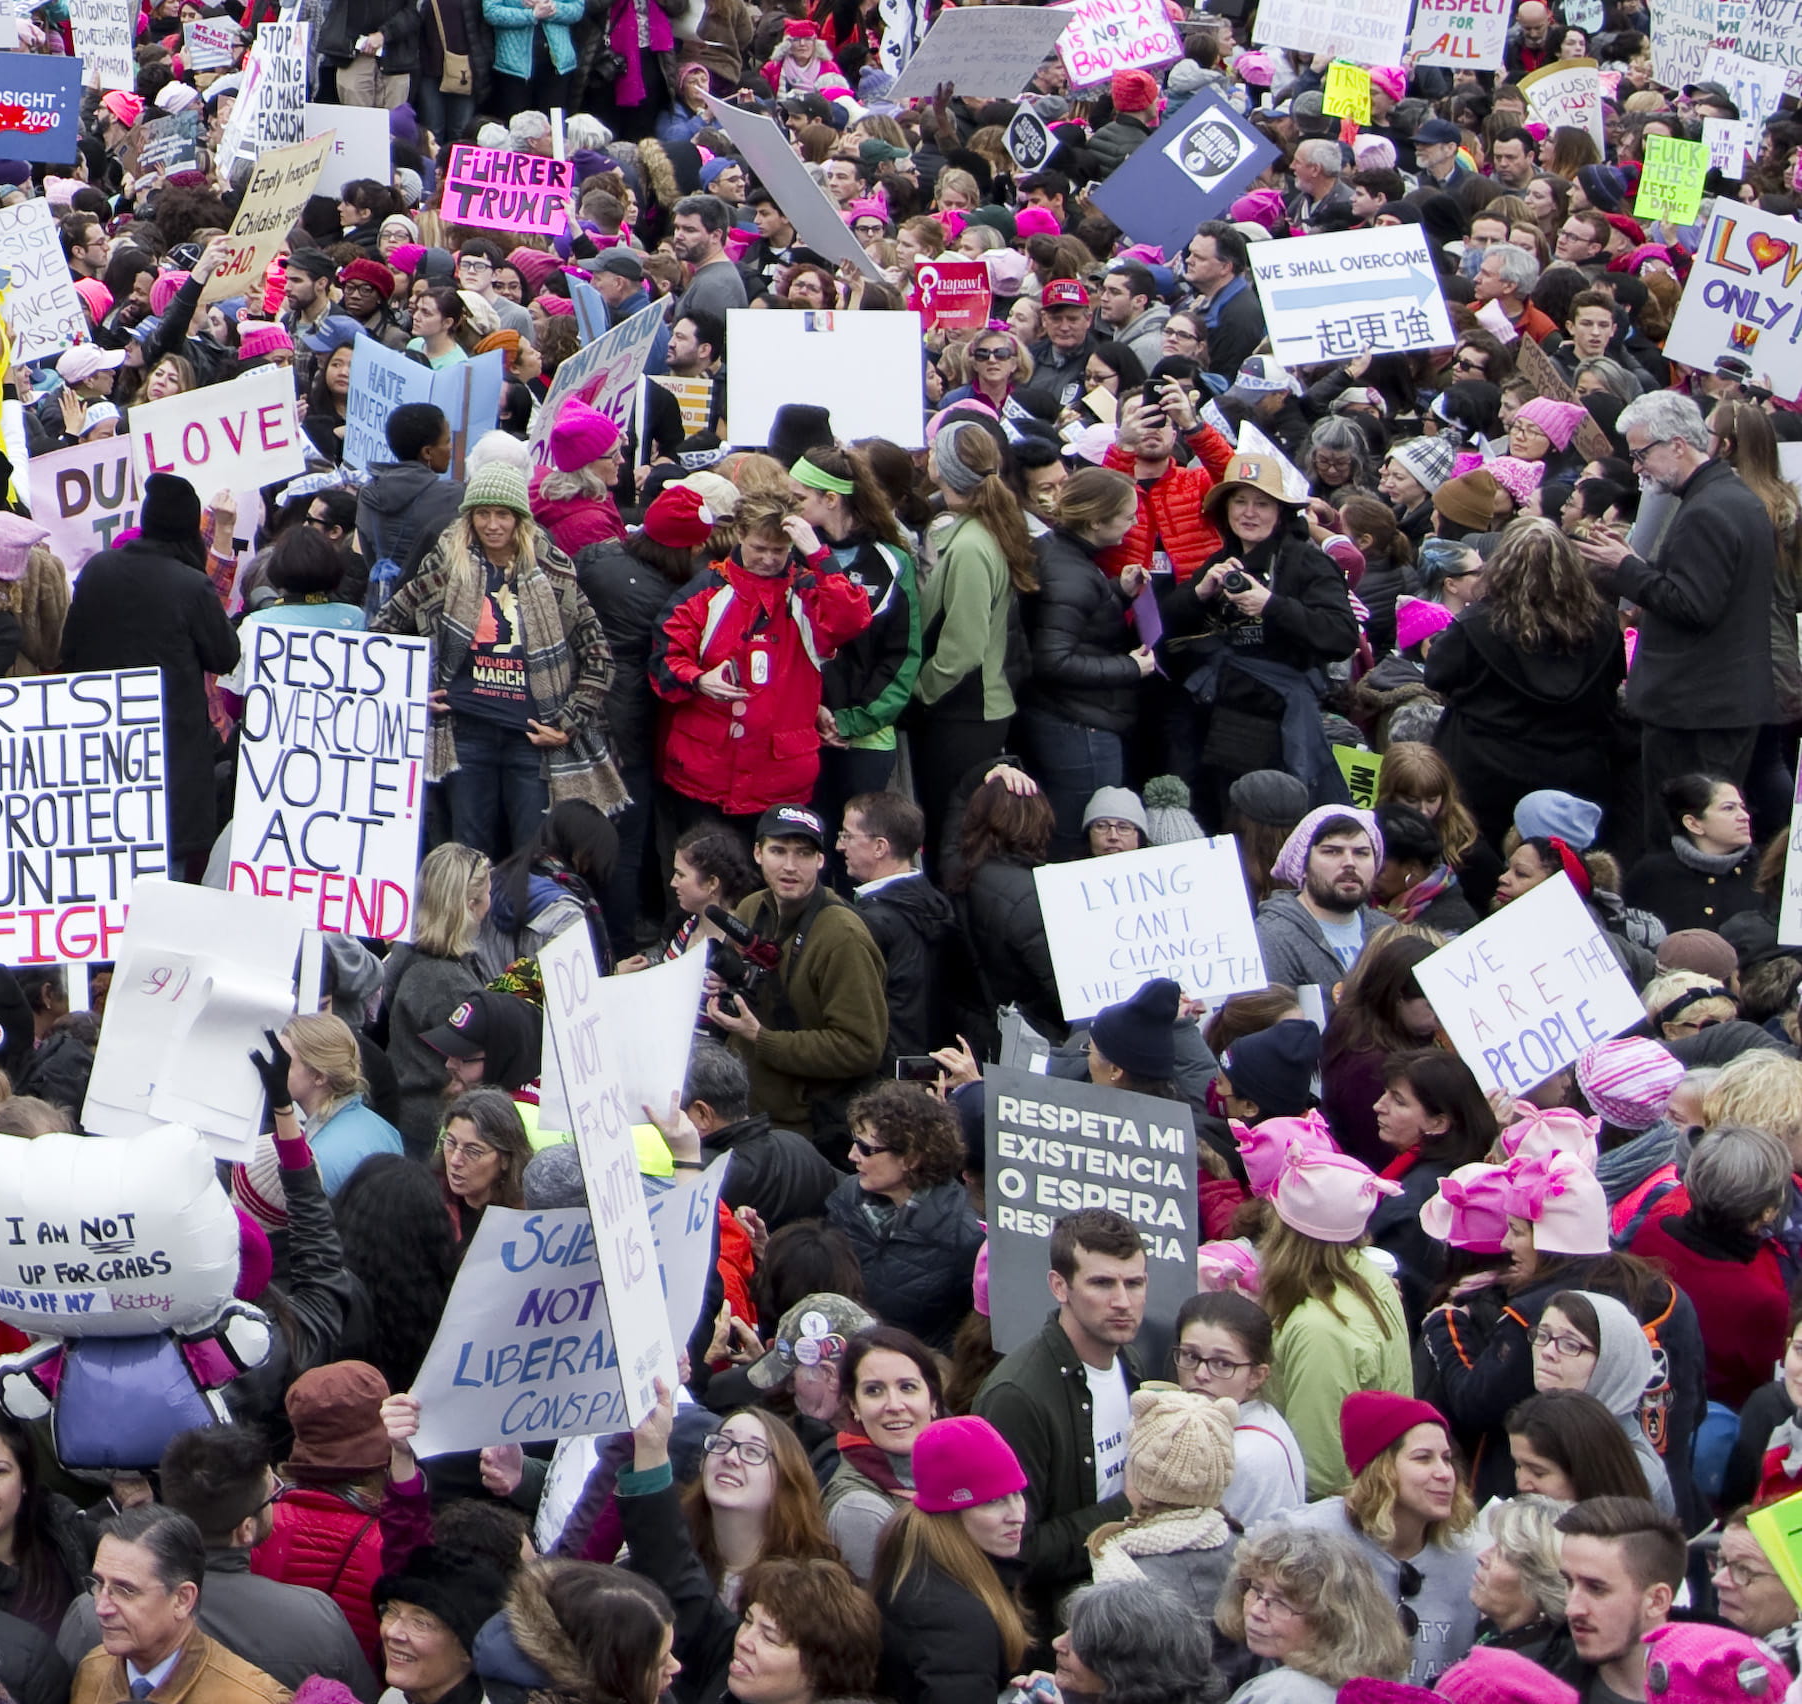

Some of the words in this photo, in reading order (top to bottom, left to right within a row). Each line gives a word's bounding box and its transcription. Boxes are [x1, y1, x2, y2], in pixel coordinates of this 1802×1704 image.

[1431, 32, 1482, 60] ALL
[1448, 15, 1474, 31] FOR
[21, 110, 61, 128] 2020
[1646, 137, 1704, 167] FUCK
[1645, 163, 1698, 188] THIS
[452, 181, 565, 225] TRUMP
[1650, 196, 1689, 214] DANCE
[1255, 264, 1283, 280] WE
[1288, 259, 1336, 277] SHALL
[1340, 249, 1429, 271] OVERCOME
[144, 403, 289, 473] LOVE
[254, 625, 426, 697] RESIST
[473, 666, 525, 686] MARCH
[241, 683, 426, 759] OVERCOME
[240, 743, 417, 819] VOTE!
[252, 809, 383, 875] ACT
[1080, 862, 1195, 912] LYING
[1115, 905, 1194, 942] CAN'T
[1109, 932, 1229, 971] CHANGE
[1444, 938, 1504, 991] WE
[1079, 975, 1129, 1004] THE
[1131, 956, 1260, 995] TRUTH
[1468, 963, 1564, 1043] ARE
[1564, 930, 1622, 985] THE
[1481, 999, 1611, 1092] PEOPLE
[998, 1095, 1142, 1146] RESPETA
[1149, 1123, 1185, 1154] MI
[998, 1131, 1186, 1190] EXISTENCIA
[997, 1168, 1027, 1199] O
[1036, 1174, 1186, 1231] ESPERA
[5, 1217, 26, 1245] I
[37, 1221, 69, 1244] AM
[80, 1213, 135, 1246] NOT
[18, 1264, 46, 1285] UP
[54, 1263, 95, 1283] FOR
[96, 1251, 172, 1281] GRABS
